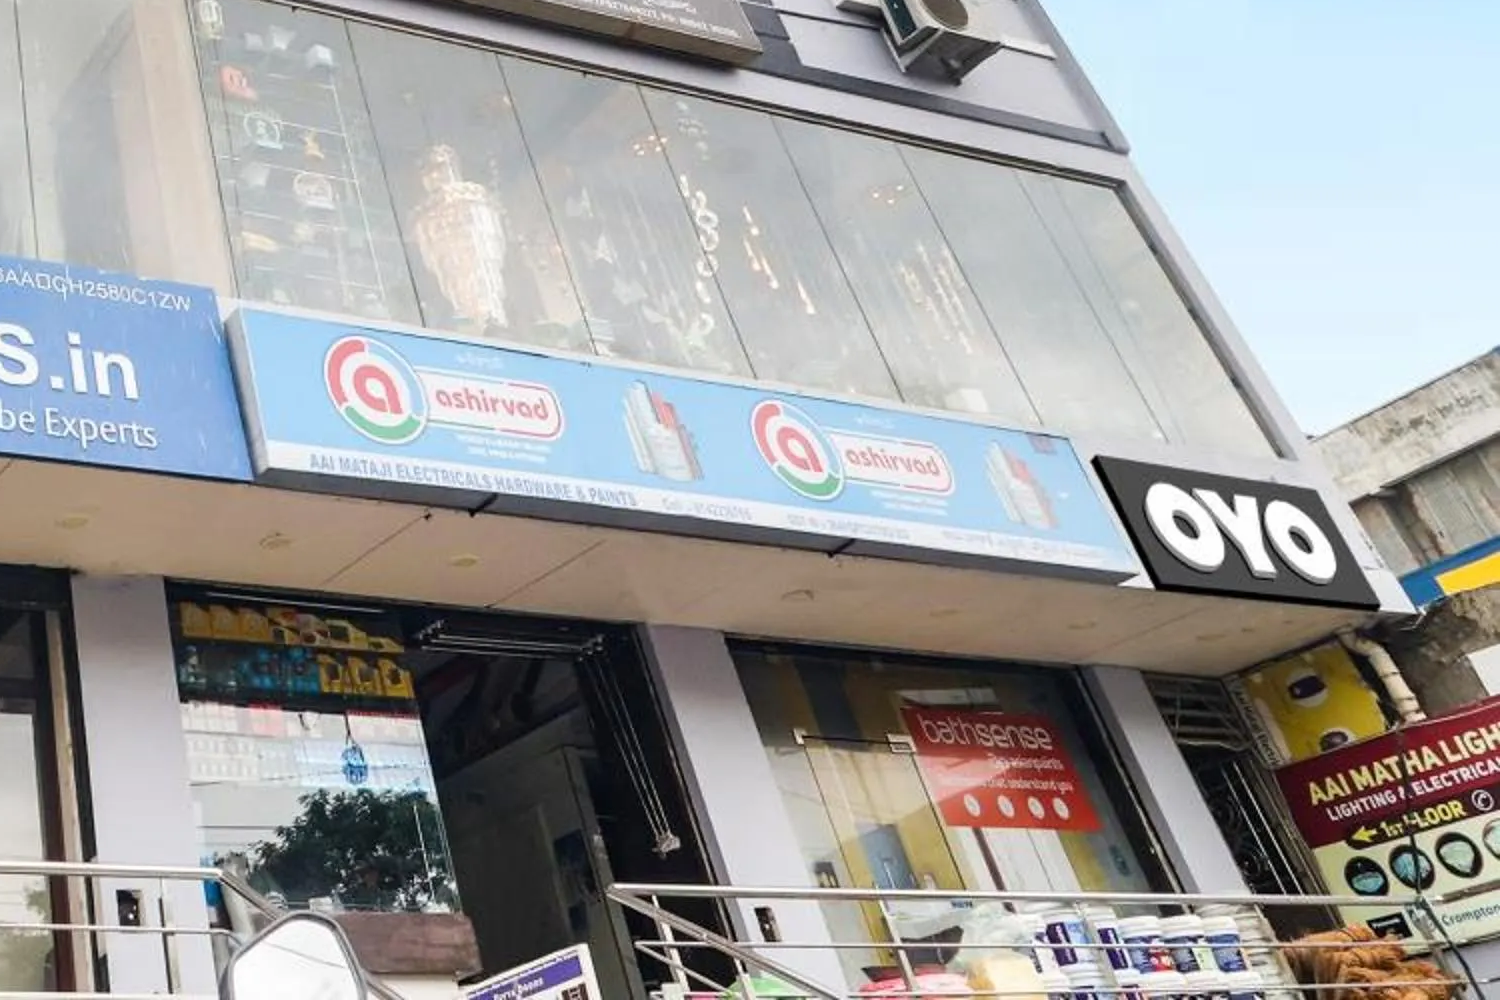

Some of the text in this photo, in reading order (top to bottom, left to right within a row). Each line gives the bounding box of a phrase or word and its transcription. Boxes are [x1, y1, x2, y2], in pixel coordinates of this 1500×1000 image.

[435, 386, 549, 421] ashirvad
[44, 407, 158, 449] Experts
[309, 453, 335, 472] AAI
[338, 457, 393, 479] MATAJI
[396, 463, 492, 491] ELECTRICALS
[495, 474, 574, 501] HARDWARE
[588, 487, 638, 508] PAINTS
[845, 446, 941, 477] ashirvad
[1144, 481, 1338, 585] OYO
[916, 712, 1053, 751] bathsense
[1308, 772, 1352, 806] AAI
[1349, 745, 1445, 791] MATHA
[1326, 788, 1397, 821] LIGHTING
